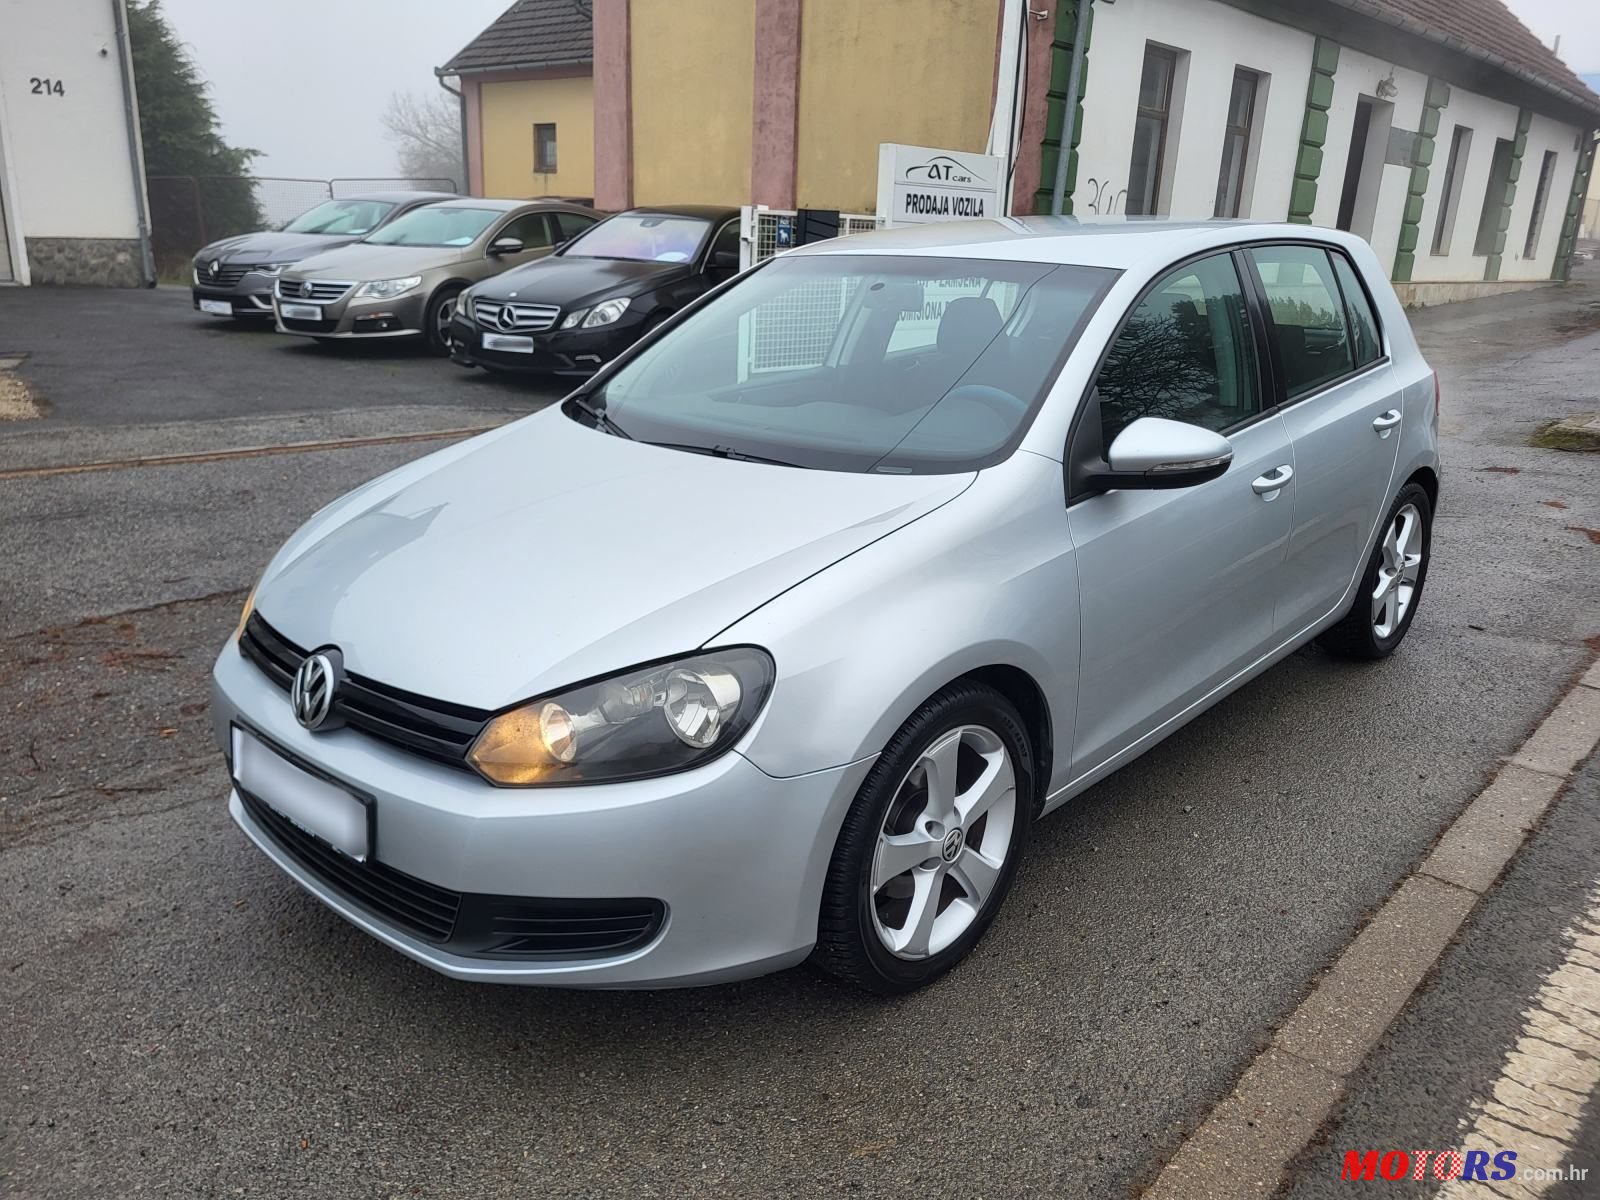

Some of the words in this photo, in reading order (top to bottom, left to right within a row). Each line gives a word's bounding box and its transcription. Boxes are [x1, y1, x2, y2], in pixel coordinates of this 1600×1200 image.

[30, 77, 65, 97] 214
[927, 164, 953, 181] AT
[952, 175, 972, 183] cars
[905, 193, 949, 216] PRODAJA
[952, 196, 984, 217] VOZILA
